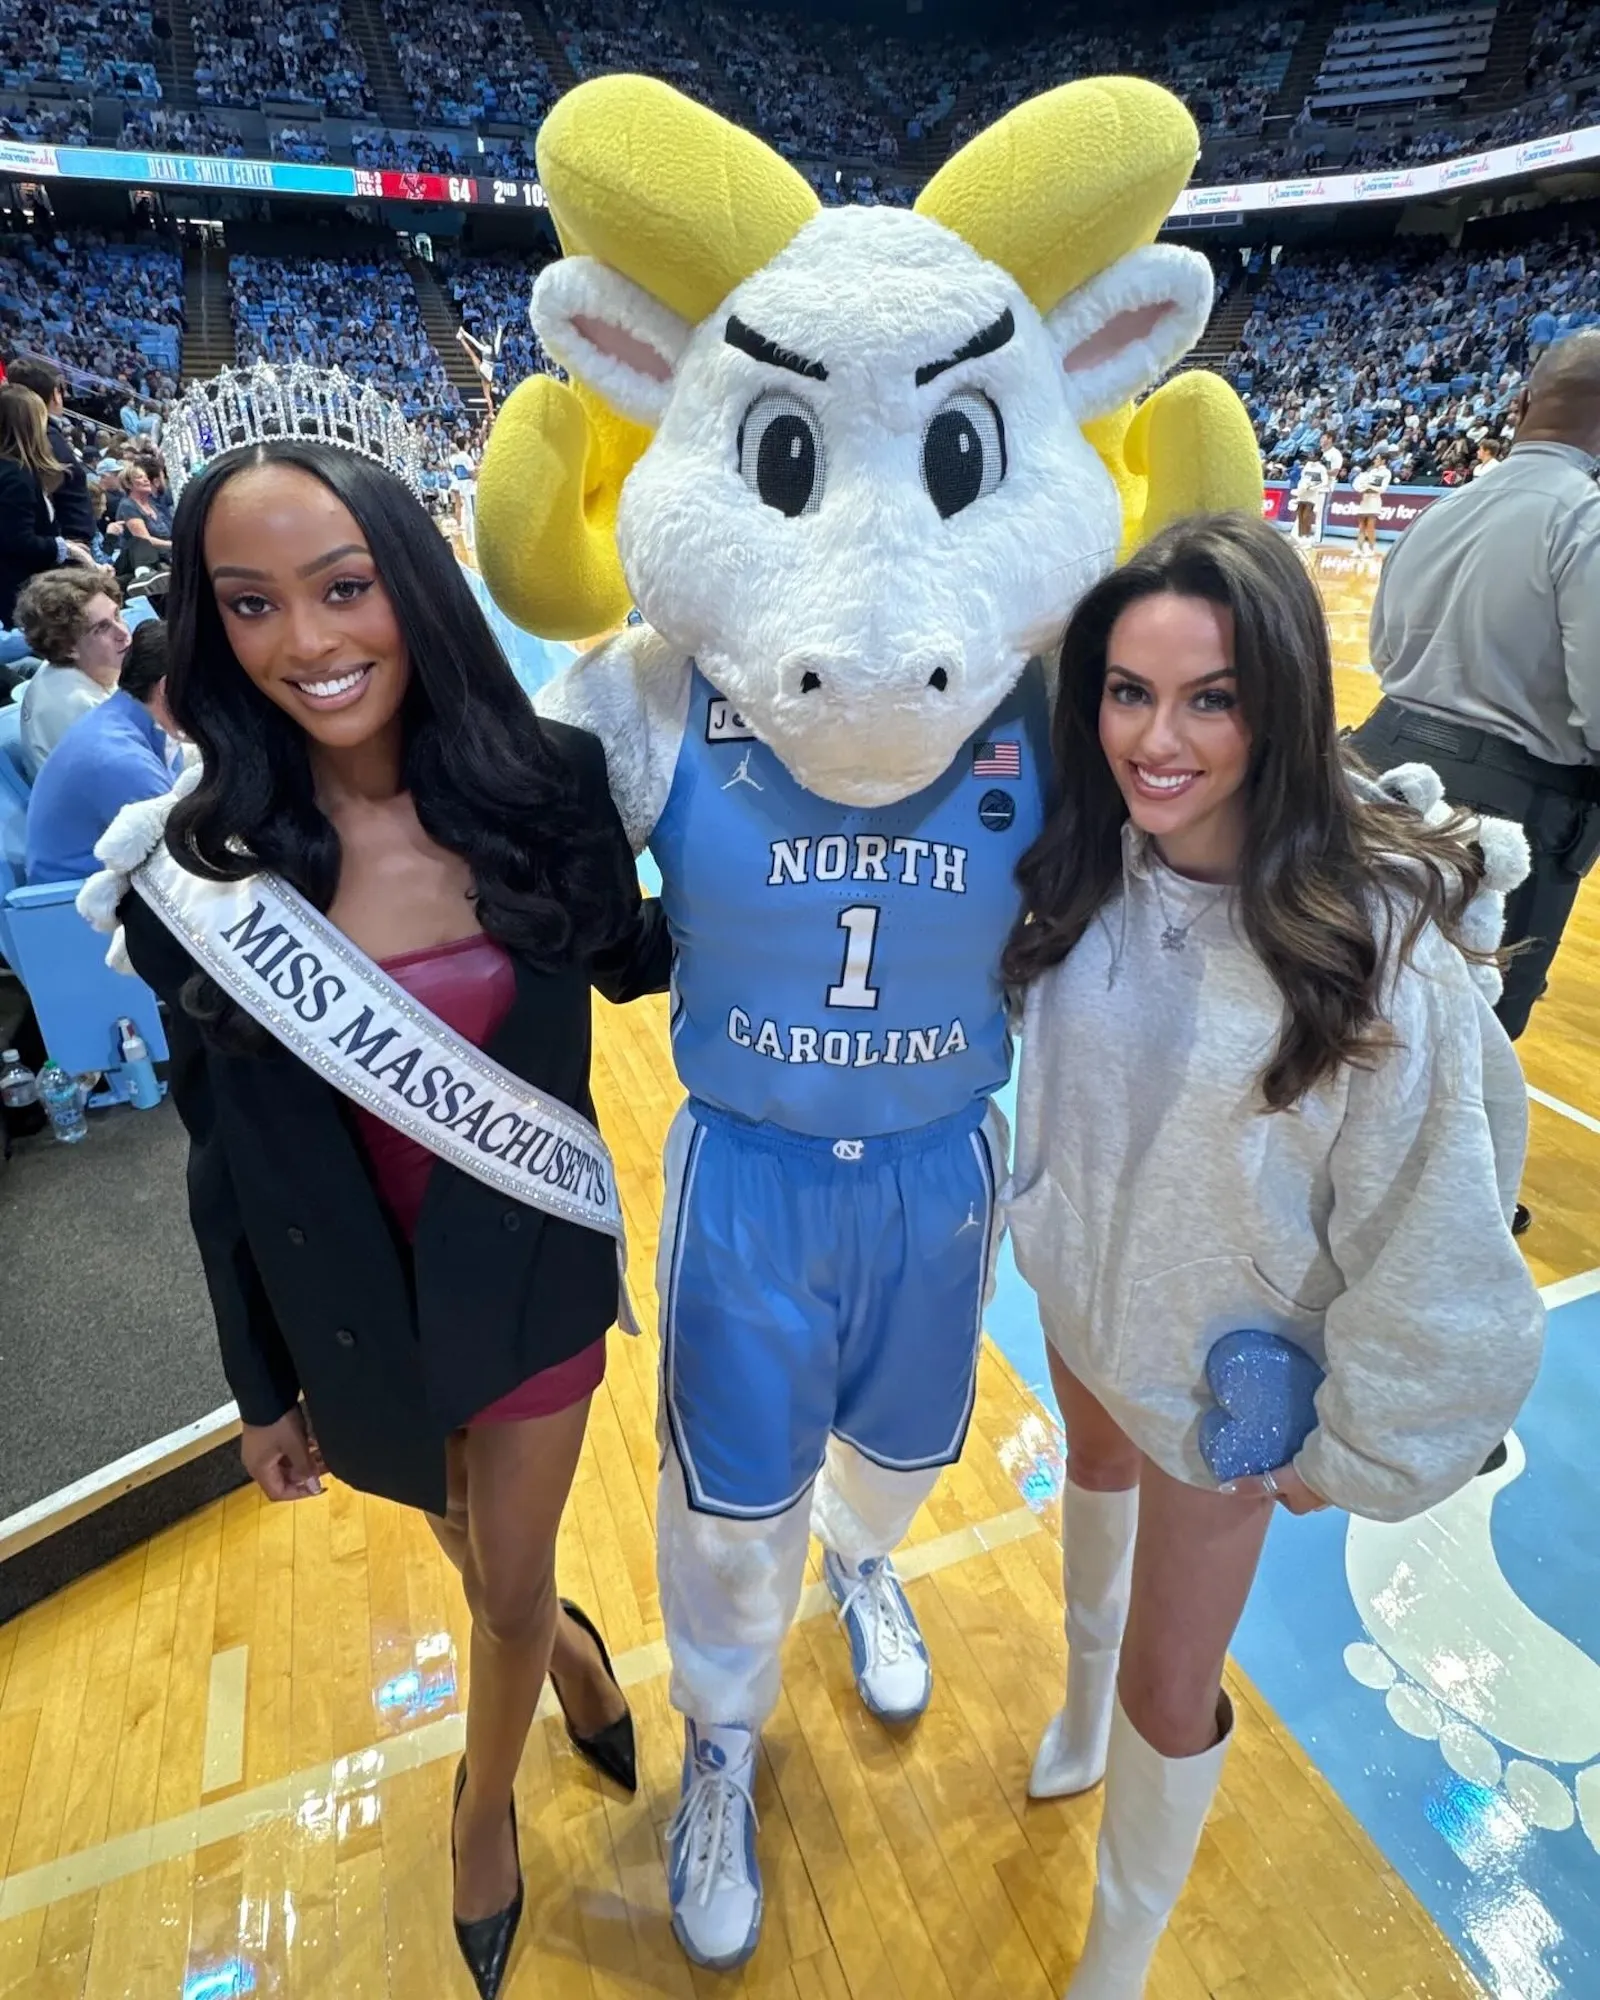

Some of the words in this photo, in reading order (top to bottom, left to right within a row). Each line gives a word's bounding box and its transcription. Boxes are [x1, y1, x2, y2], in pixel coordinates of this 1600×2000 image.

[147, 157, 178, 180] DEAN
[193, 160, 231, 183] SMITH
[233, 163, 273, 187] CENTER
[449, 177, 471, 203] 64
[767, 834, 968, 893] NORTH
[825, 904, 881, 1010] 1
[220, 901, 345, 1022] MISS
[329, 1005, 607, 1206] MASSACHUSETTS
[728, 1005, 969, 1068] CAROLINA
